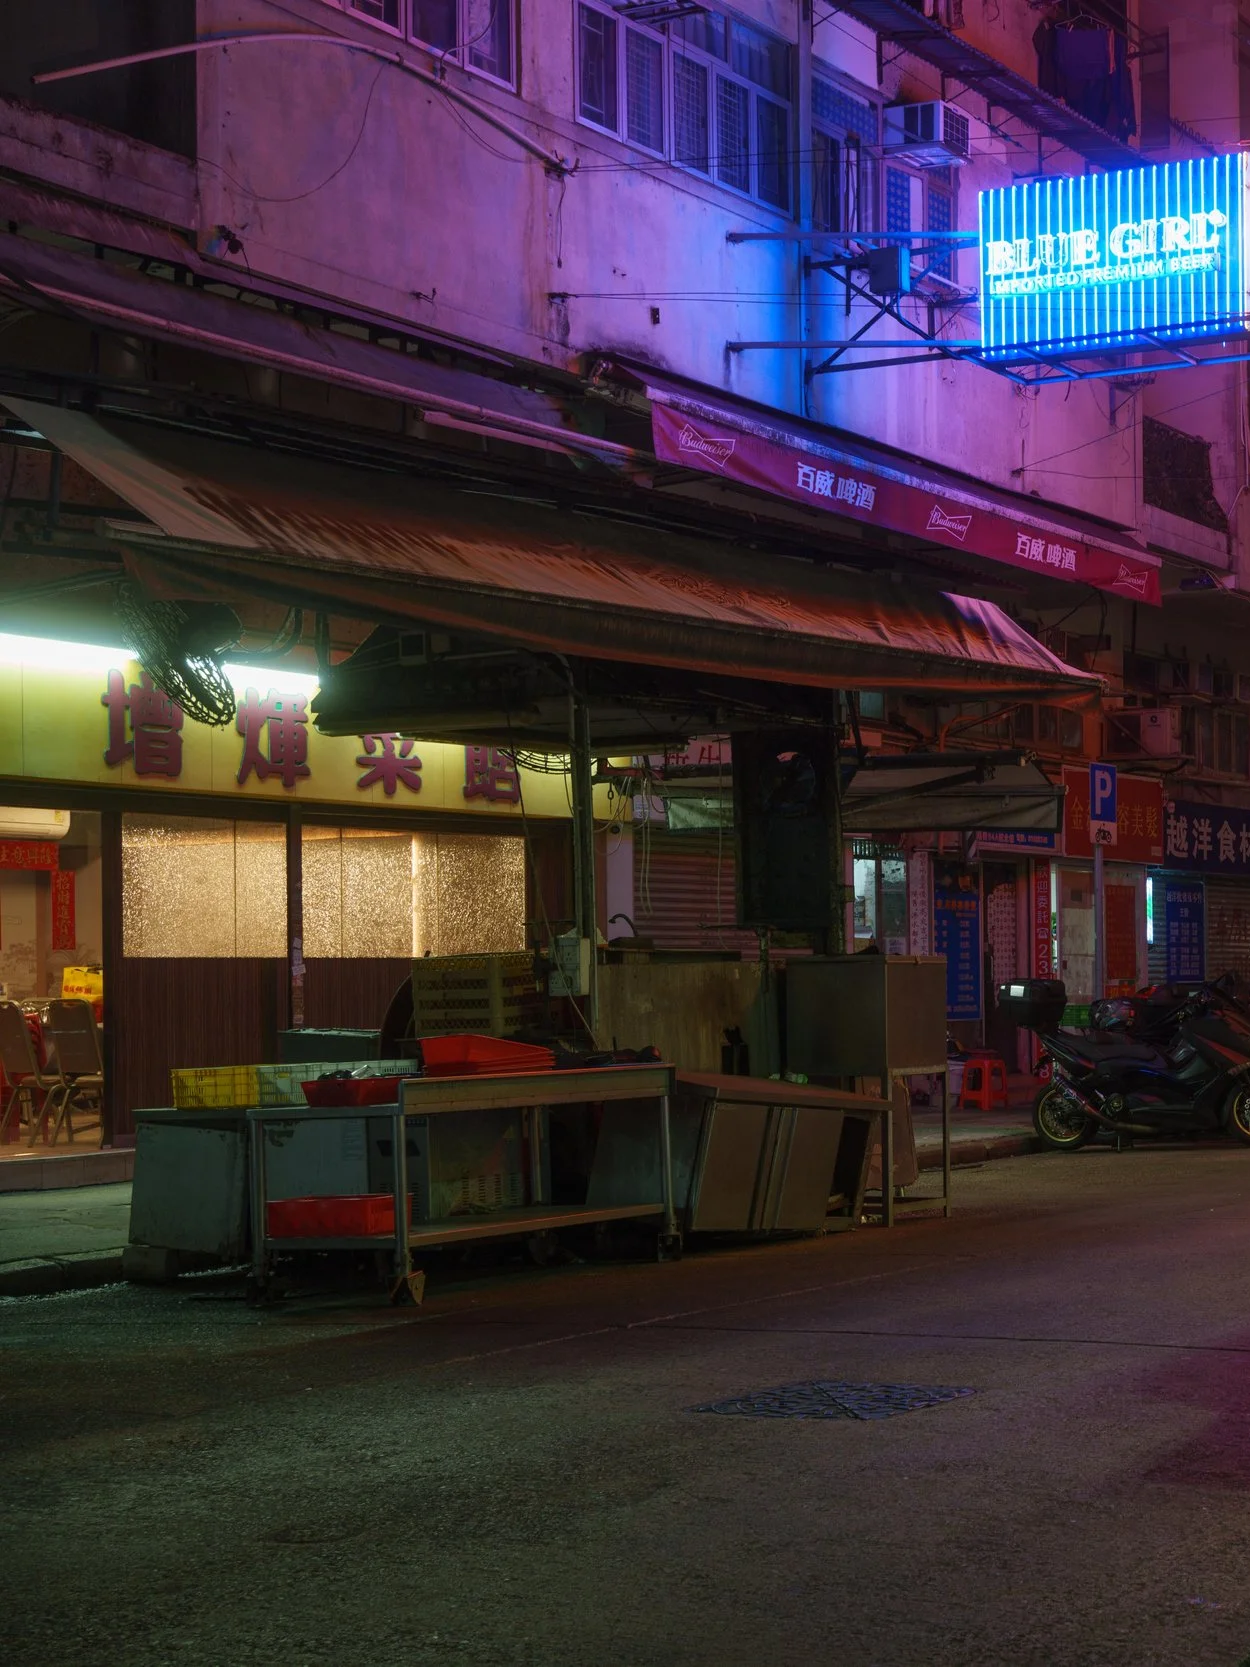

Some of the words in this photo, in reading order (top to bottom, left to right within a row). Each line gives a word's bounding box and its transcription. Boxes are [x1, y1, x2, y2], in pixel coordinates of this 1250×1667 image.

[985, 228, 1101, 276] BLUE
[1083, 260, 1164, 286] PREMIUM
[1170, 254, 1215, 273] BEER
[679, 427, 735, 459] Budweiser
[796, 461, 876, 513] 百威啤酒
[930, 510, 968, 533] Budweiser
[1016, 531, 1077, 573] 百威啤酒
[1095, 769, 1112, 815] P
[1071, 796, 1158, 839] 金容美髮
